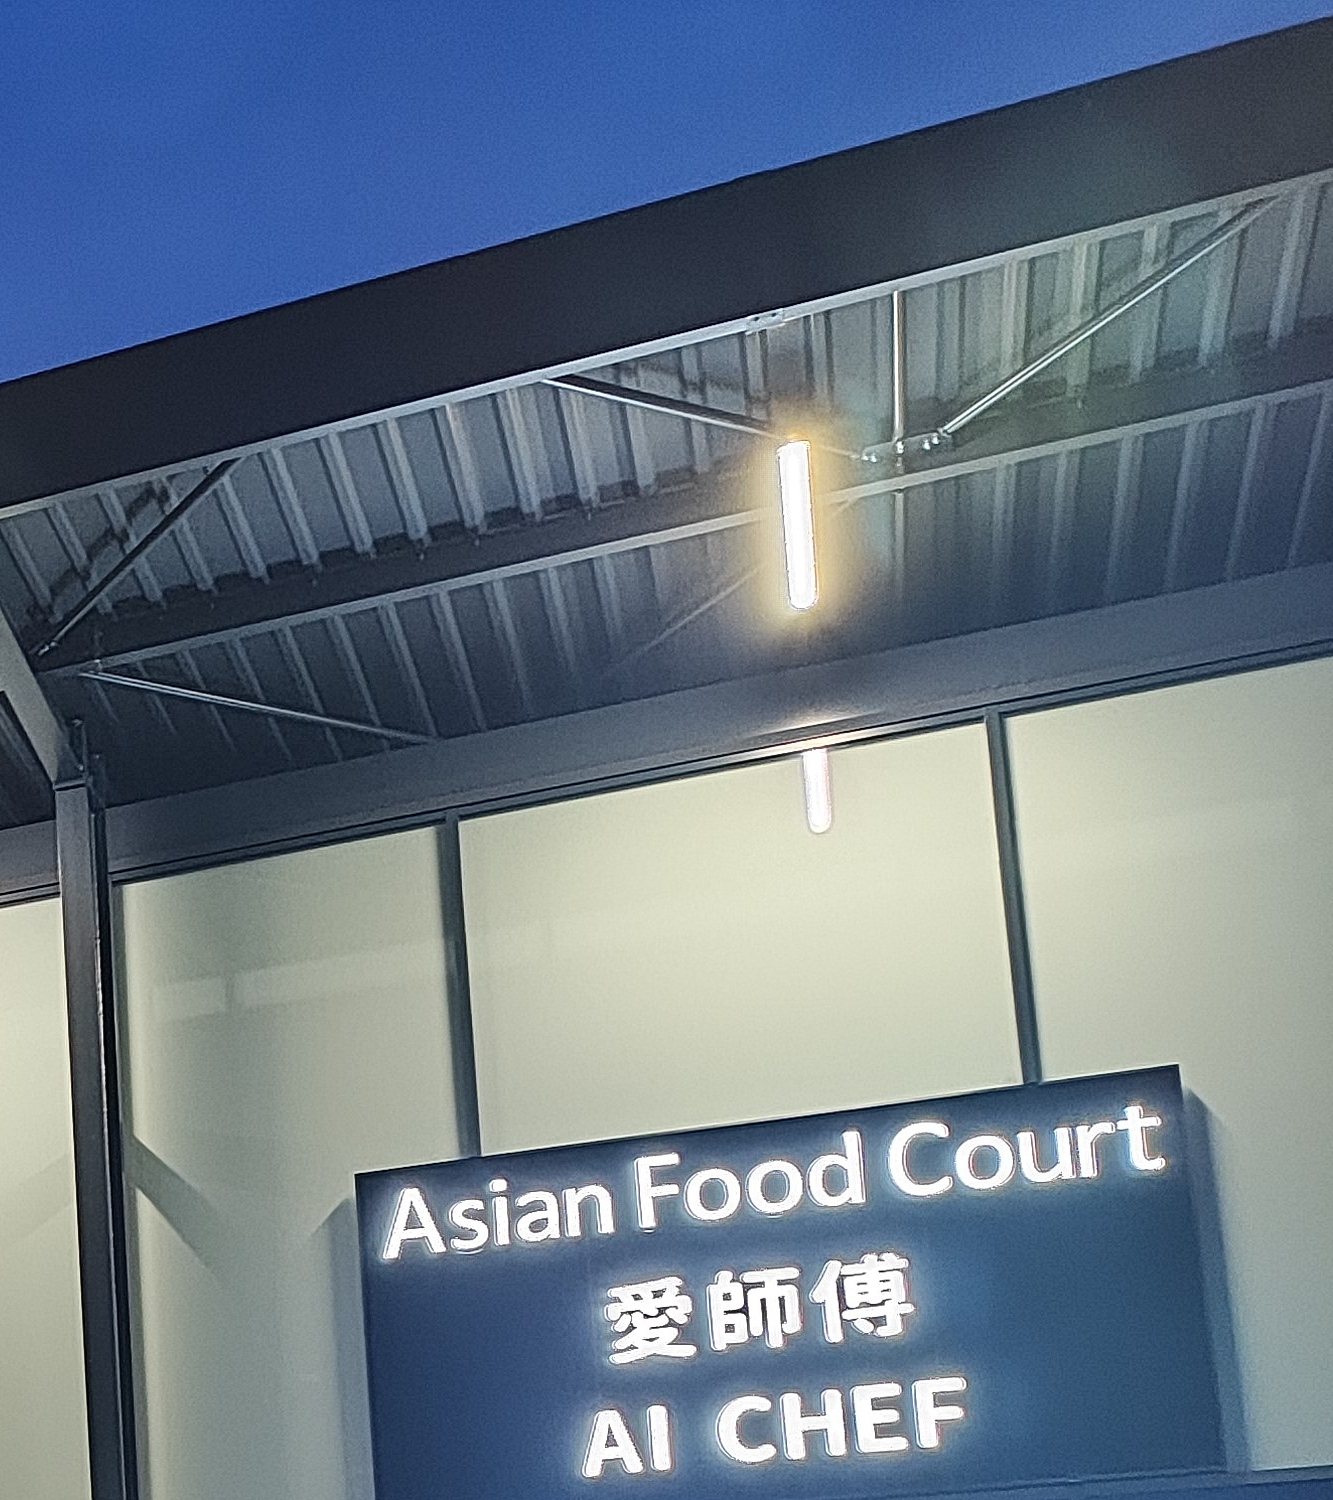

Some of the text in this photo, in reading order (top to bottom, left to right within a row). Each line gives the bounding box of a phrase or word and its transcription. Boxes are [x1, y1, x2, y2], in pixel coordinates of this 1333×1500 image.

[383, 1103, 1168, 1261] Asian Food Court
[605, 1251, 916, 1366] 愛師傅
[582, 1376, 967, 1479] AI CHEF
